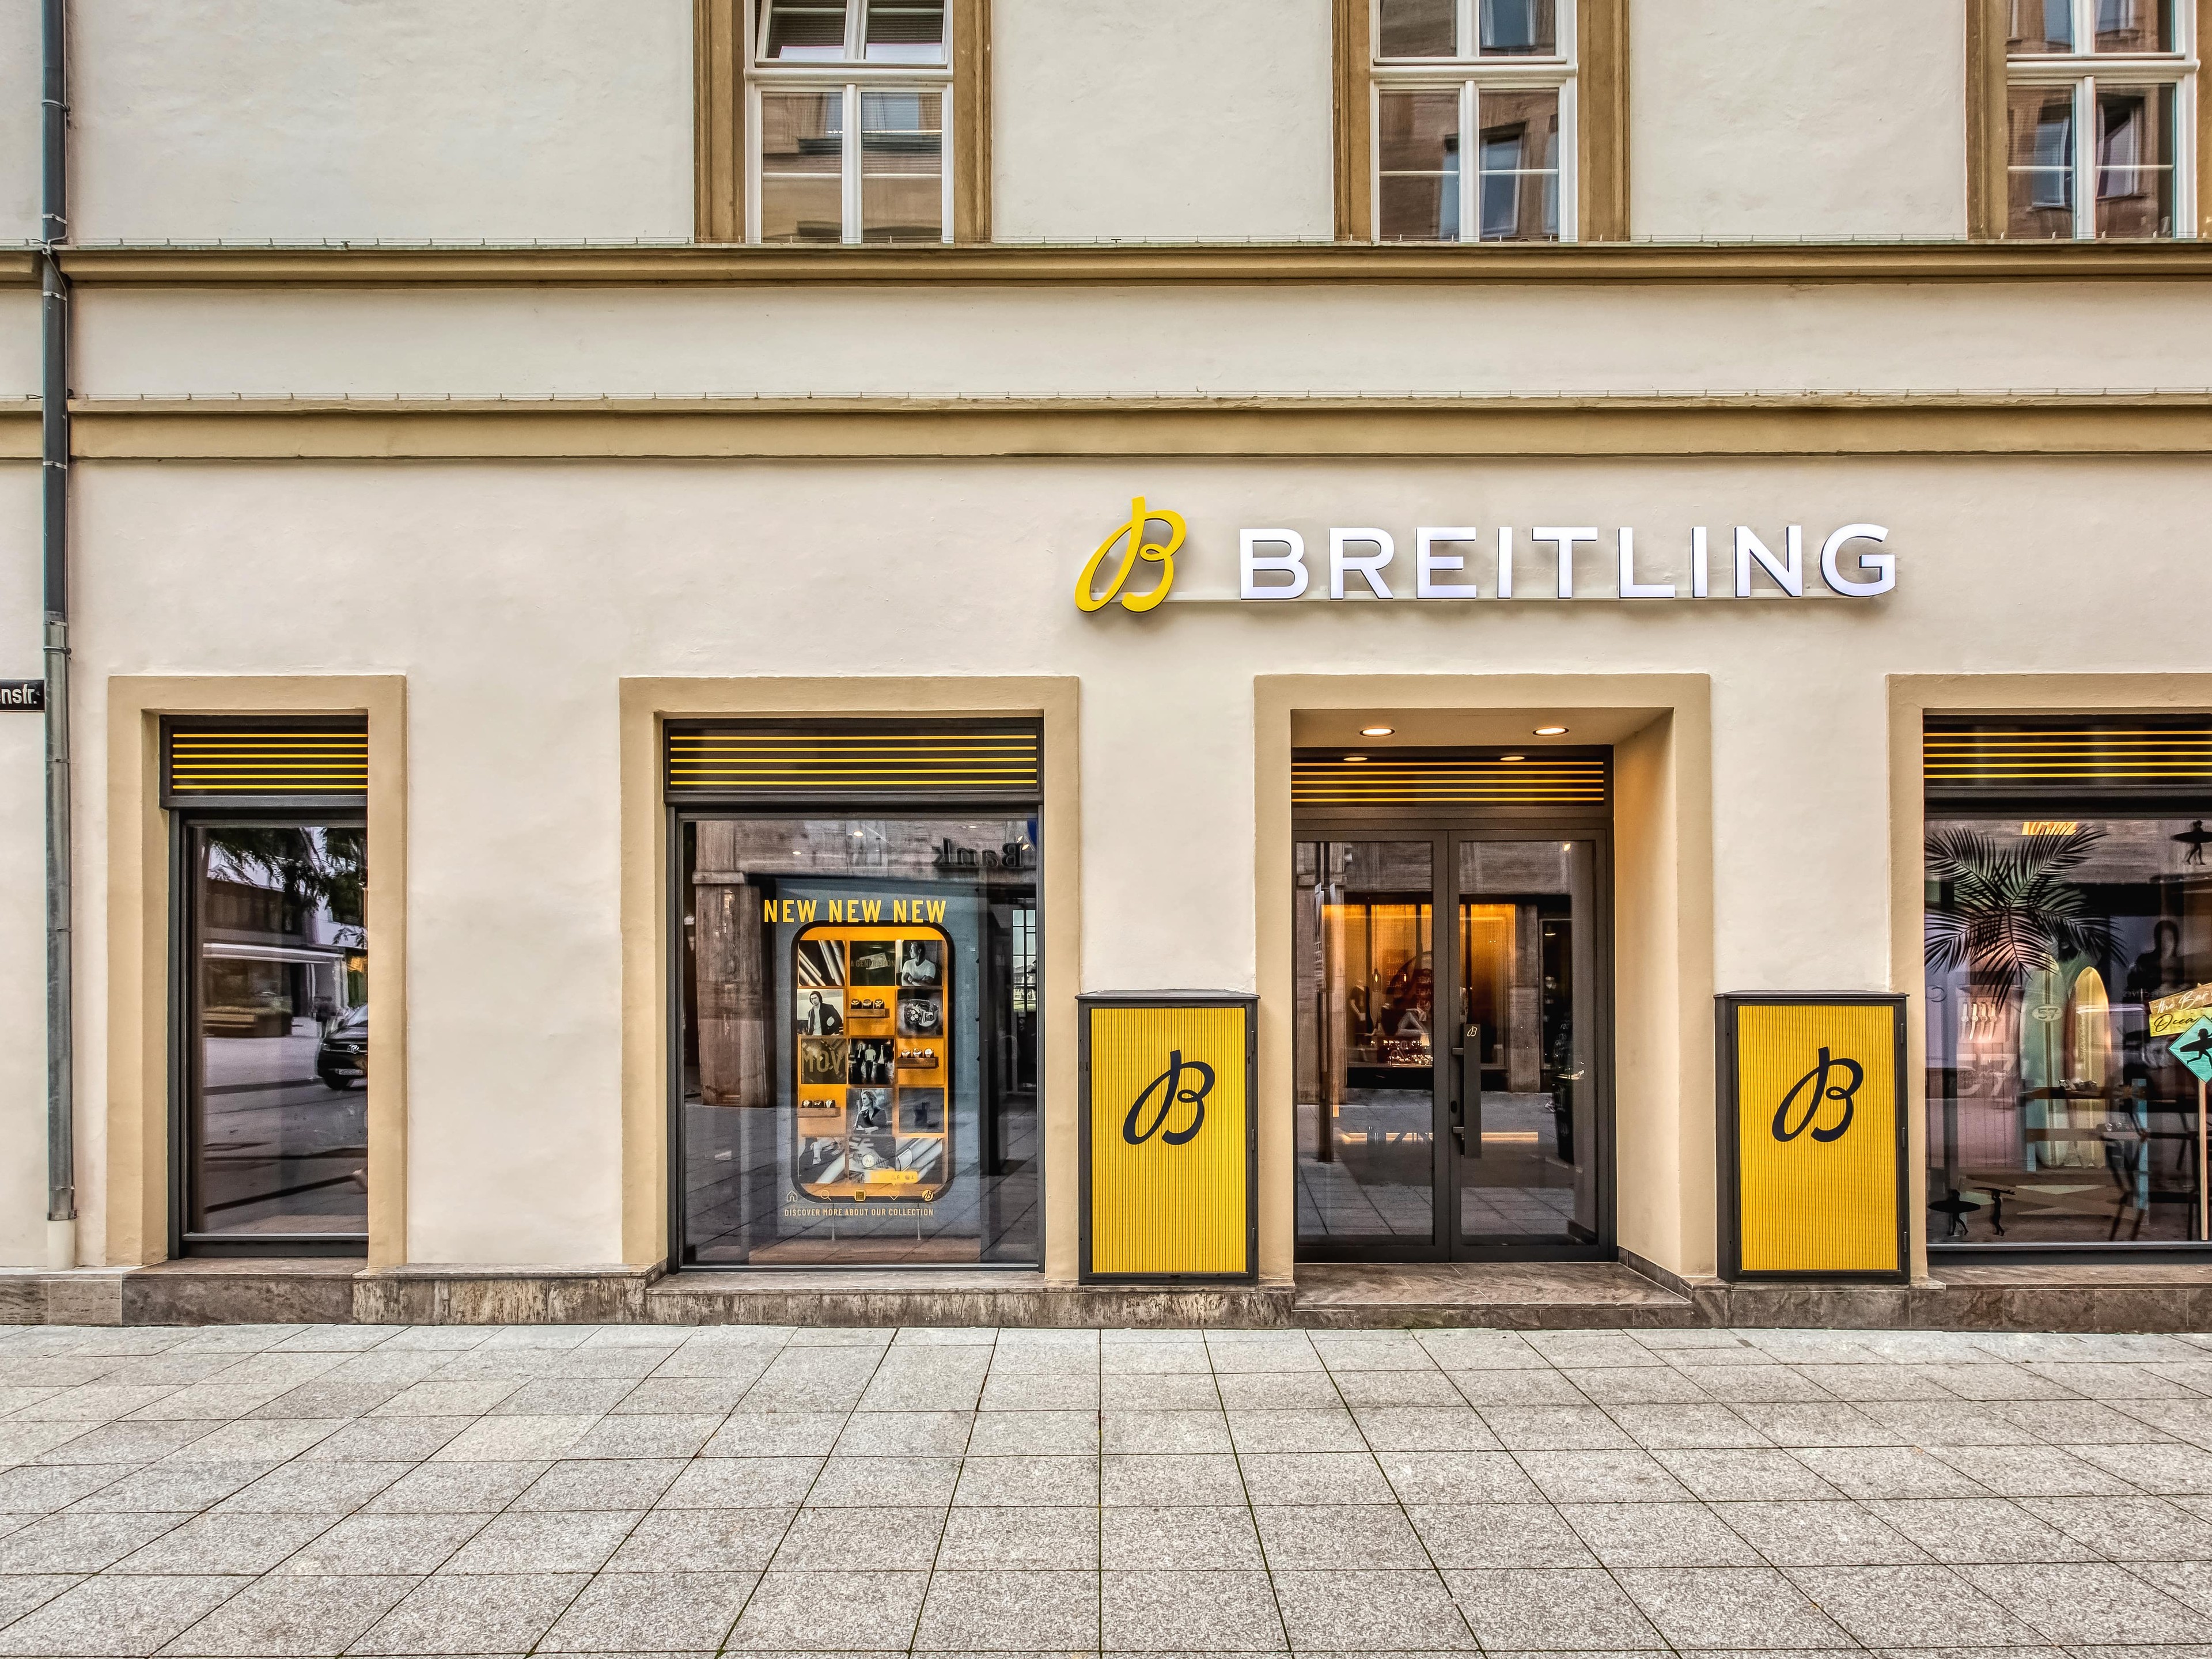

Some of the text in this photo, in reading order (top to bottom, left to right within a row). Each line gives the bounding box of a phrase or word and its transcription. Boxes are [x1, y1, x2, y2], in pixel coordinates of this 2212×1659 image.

[1240, 523, 1896, 600] BREITLING
[0, 684, 37, 704] nstr.
[764, 899, 946, 923] NEW NEW NEW
[2154, 990, 2212, 1014] the Bar
[2037, 1007, 2058, 1019] 57
[2154, 1013, 2198, 1032] Ocea
[784, 1209, 934, 1217] DISCOVER MORE ABOUT OUR COLLECTION
